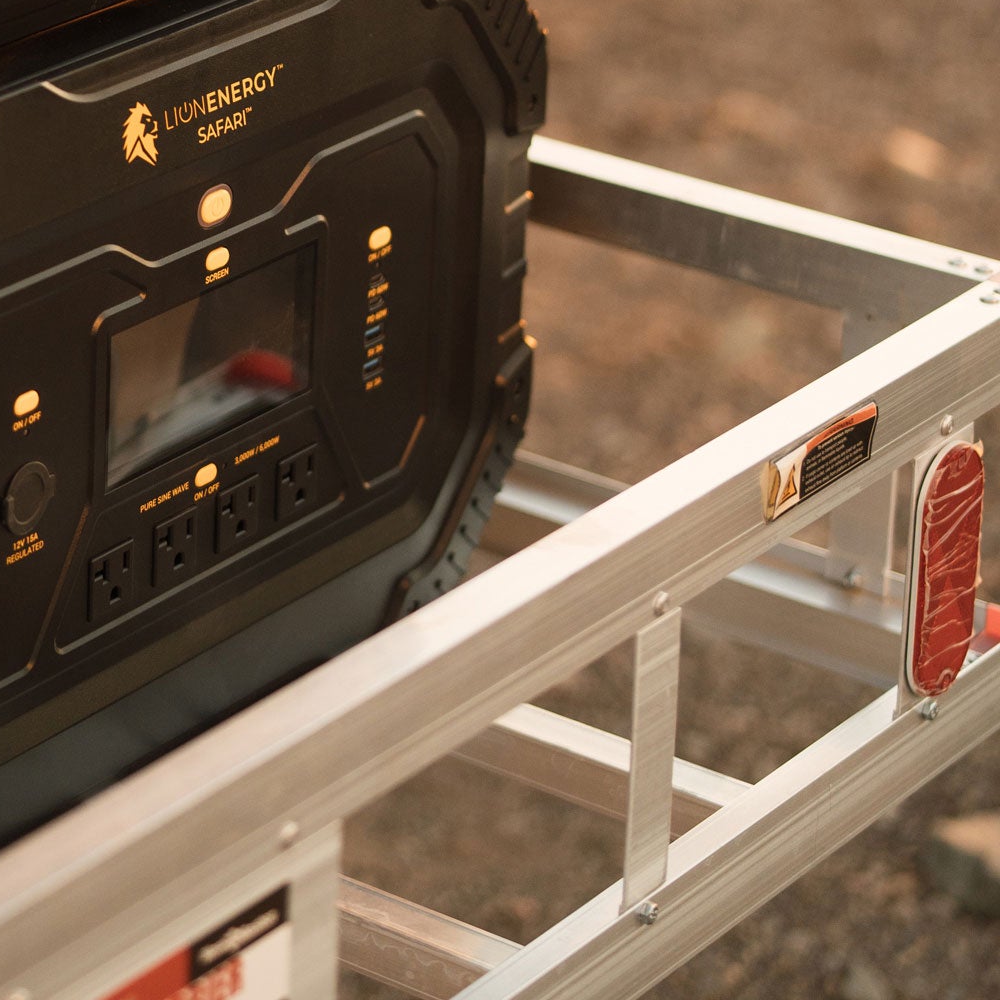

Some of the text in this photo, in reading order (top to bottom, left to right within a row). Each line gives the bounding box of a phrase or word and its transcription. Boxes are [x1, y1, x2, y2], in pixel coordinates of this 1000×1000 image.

[205, 267, 230, 285] SCREEN
[12, 419, 25, 432] ON
[28, 411, 42, 425] OFF
[140, 481, 190, 513] PURE SINE WAVE
[193, 491, 204, 502] ON
[208, 482, 220, 495] OFF
[13, 532, 39, 551] 12V 15A
[6, 540, 45, 566] REGULATED
